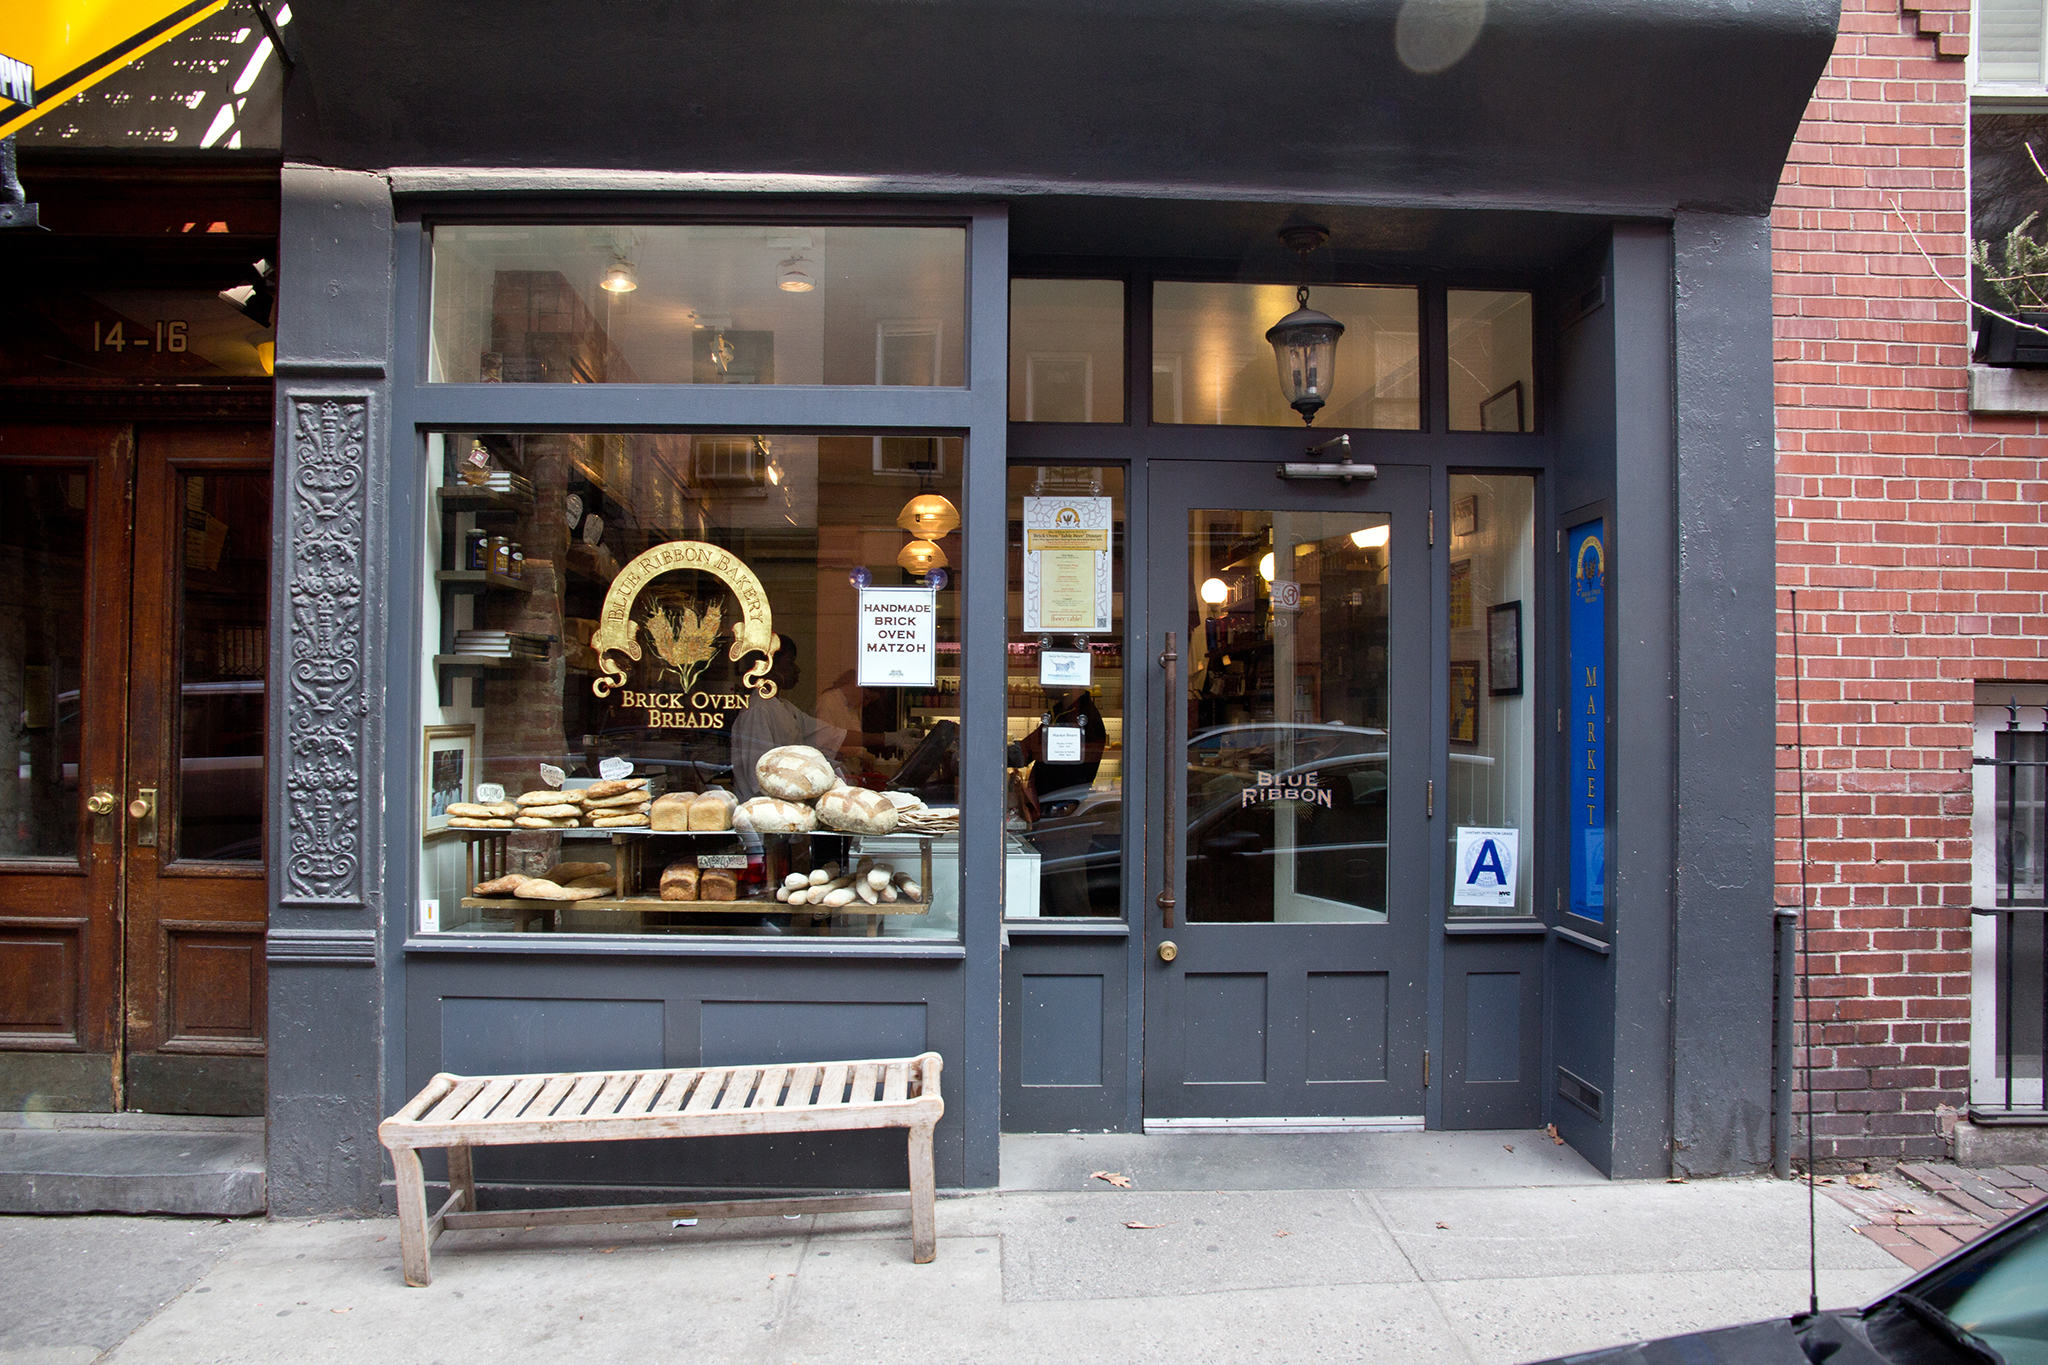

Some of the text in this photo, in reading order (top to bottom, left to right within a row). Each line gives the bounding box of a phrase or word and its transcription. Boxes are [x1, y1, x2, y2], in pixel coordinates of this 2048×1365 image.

[94, 321, 189, 352] 14-16
[607, 547, 764, 624] BLUE RIBBON BAKERY
[864, 604, 931, 613] HANDMADE
[874, 617, 916, 626] BRICK
[878, 630, 916, 639] OVEN
[867, 643, 926, 653] MATZOH
[621, 690, 751, 709] BRICK OVEN
[647, 709, 725, 729] BREADS
[1585, 666, 1597, 826] MARKET
[1257, 770, 1318, 787] BLUE
[1242, 788, 1332, 809] RIBBON
[1466, 838, 1507, 885] A
